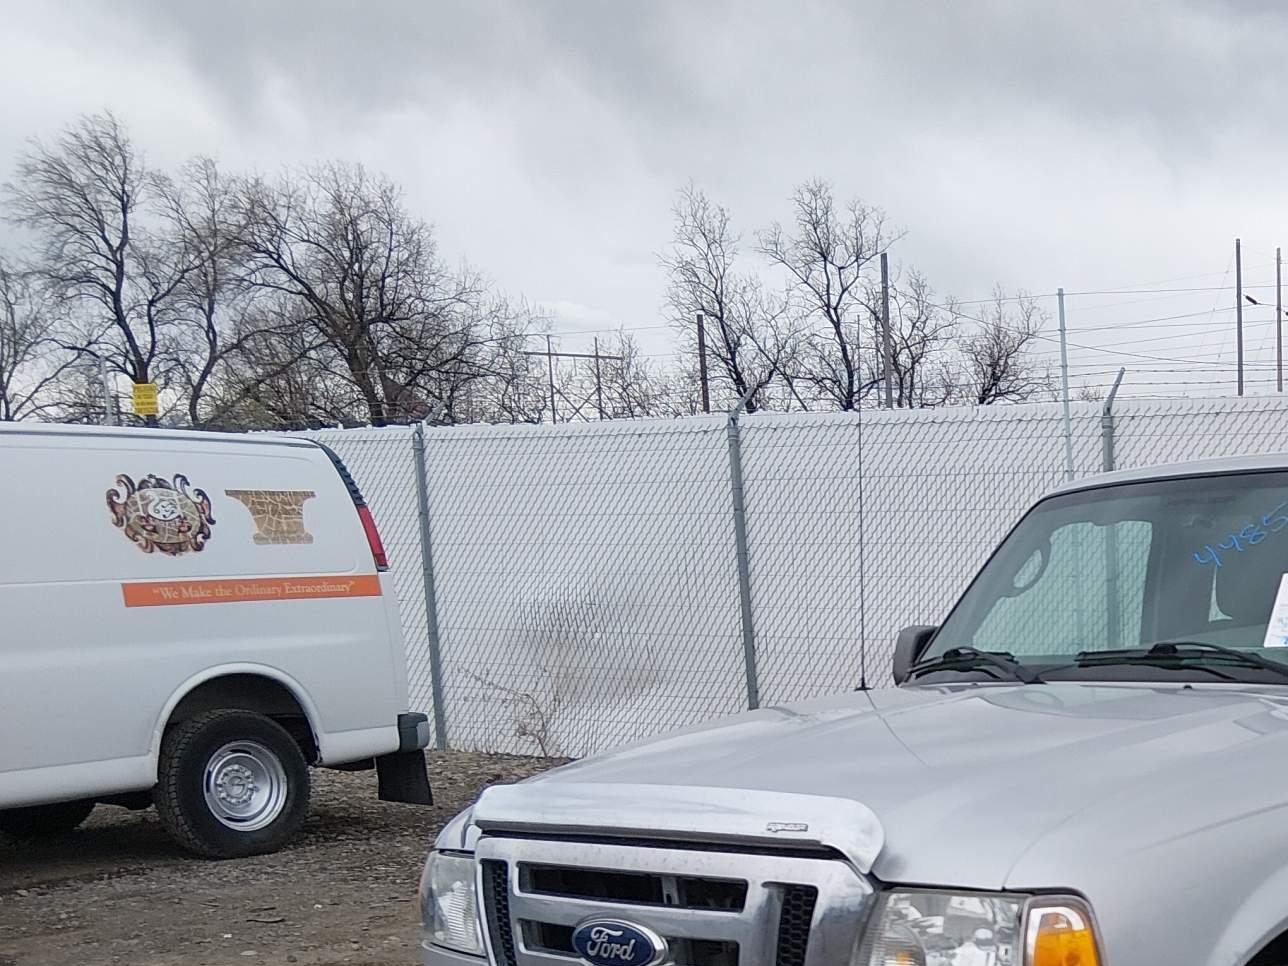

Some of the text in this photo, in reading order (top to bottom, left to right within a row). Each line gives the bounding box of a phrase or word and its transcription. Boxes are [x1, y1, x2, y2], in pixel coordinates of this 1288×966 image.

[182, 585, 212, 599] Make
[215, 584, 233, 597] the
[235, 583, 282, 599] Ordinary
[586, 926, 636, 961] Ford
